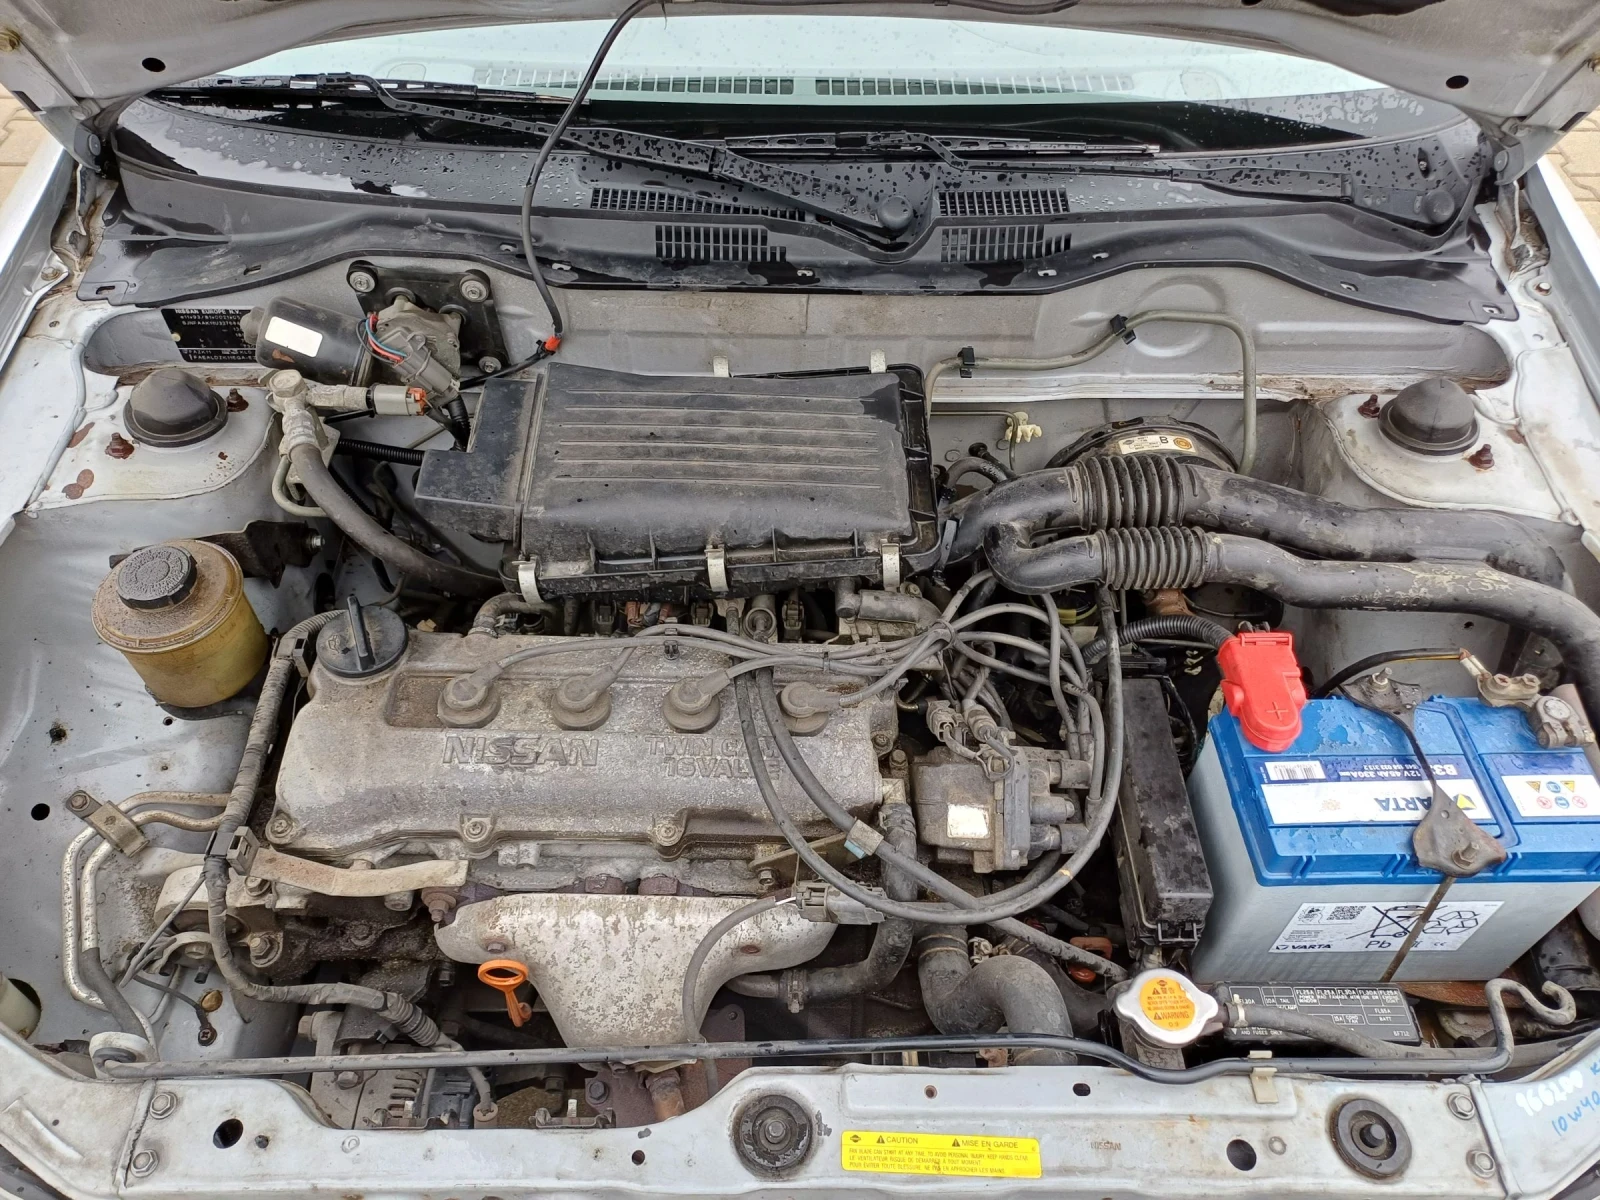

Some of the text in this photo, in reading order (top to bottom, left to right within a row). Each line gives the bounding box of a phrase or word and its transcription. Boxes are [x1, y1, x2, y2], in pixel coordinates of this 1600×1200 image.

[1159, 436, 1169, 444] B
[442, 736, 600, 767] NISSAN
[644, 736, 714, 757] TWIN
[1373, 796, 1435, 812] ARTA
[1365, 940, 1392, 949] Pb
[1160, 1010, 1190, 1020] WARNING
[886, 1136, 919, 1144] CAUTION
[993, 1141, 1019, 1149] GARDE
[1090, 1140, 1122, 1151] NISSAN
